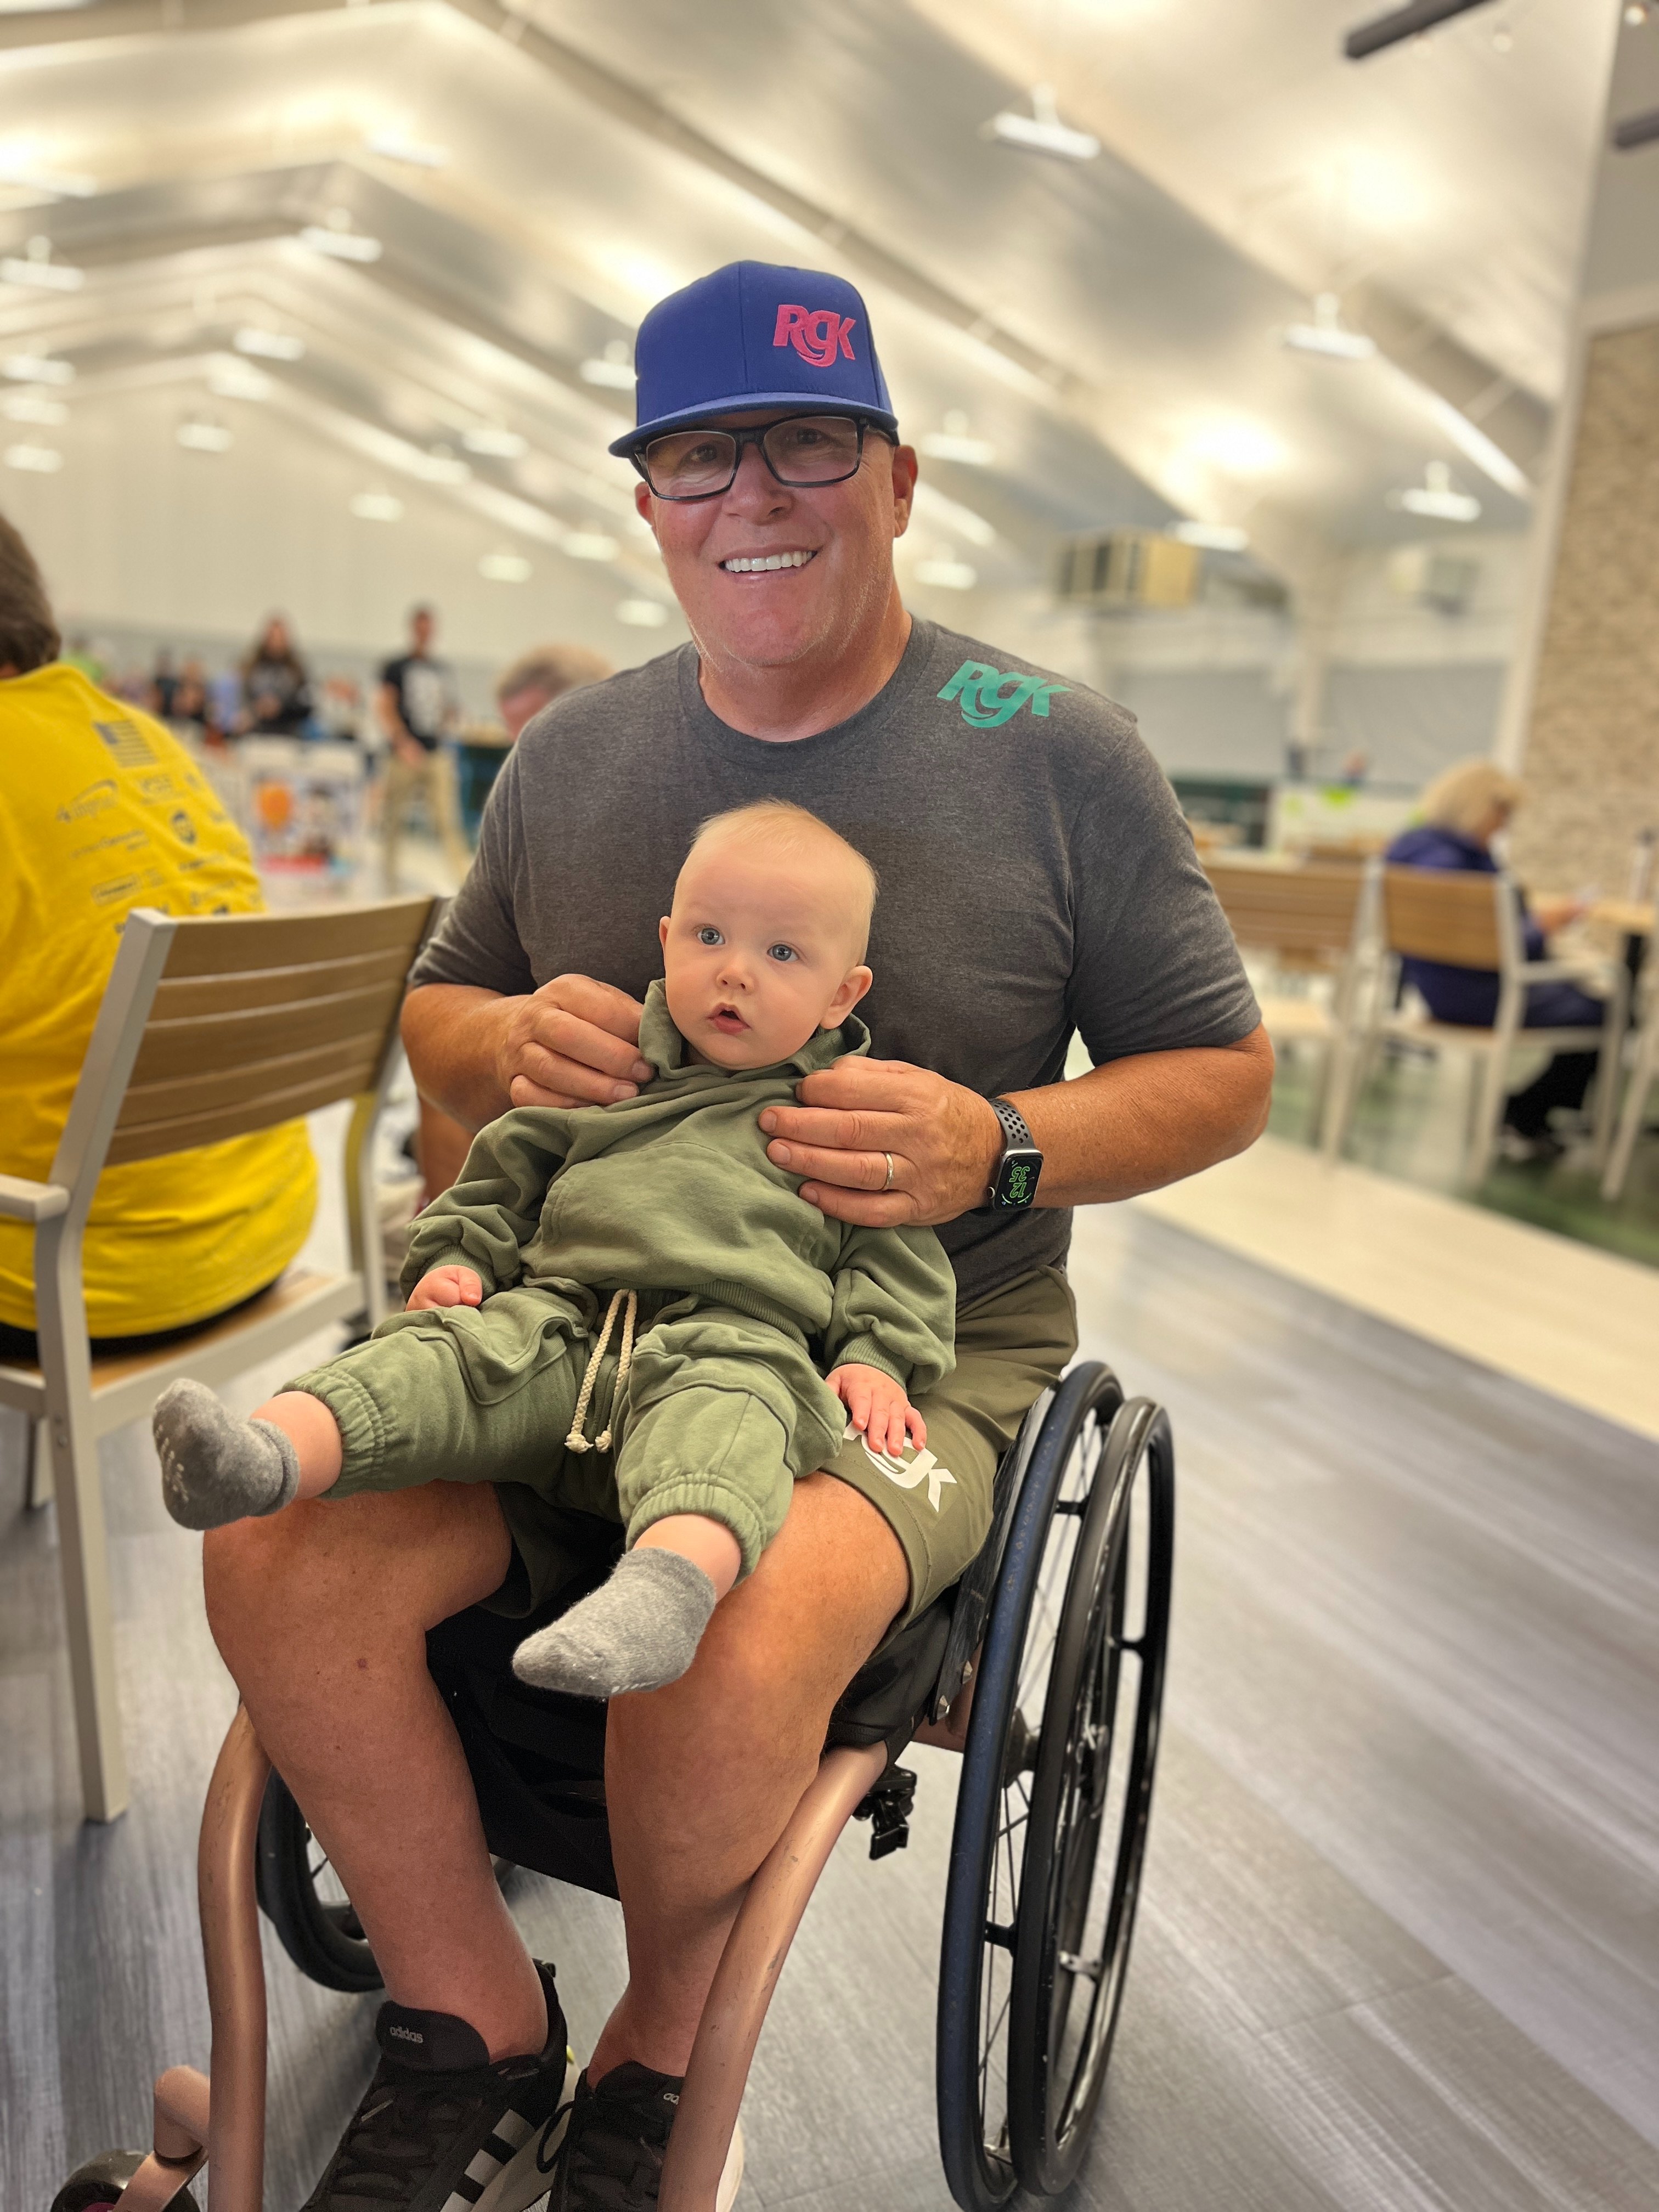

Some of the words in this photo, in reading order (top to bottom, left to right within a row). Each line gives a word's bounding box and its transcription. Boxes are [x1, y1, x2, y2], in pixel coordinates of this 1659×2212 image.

[1008, 1166, 1030, 1182] 35
[1009, 1182, 1027, 1198] 12
[390, 2026, 424, 2044] adidas
